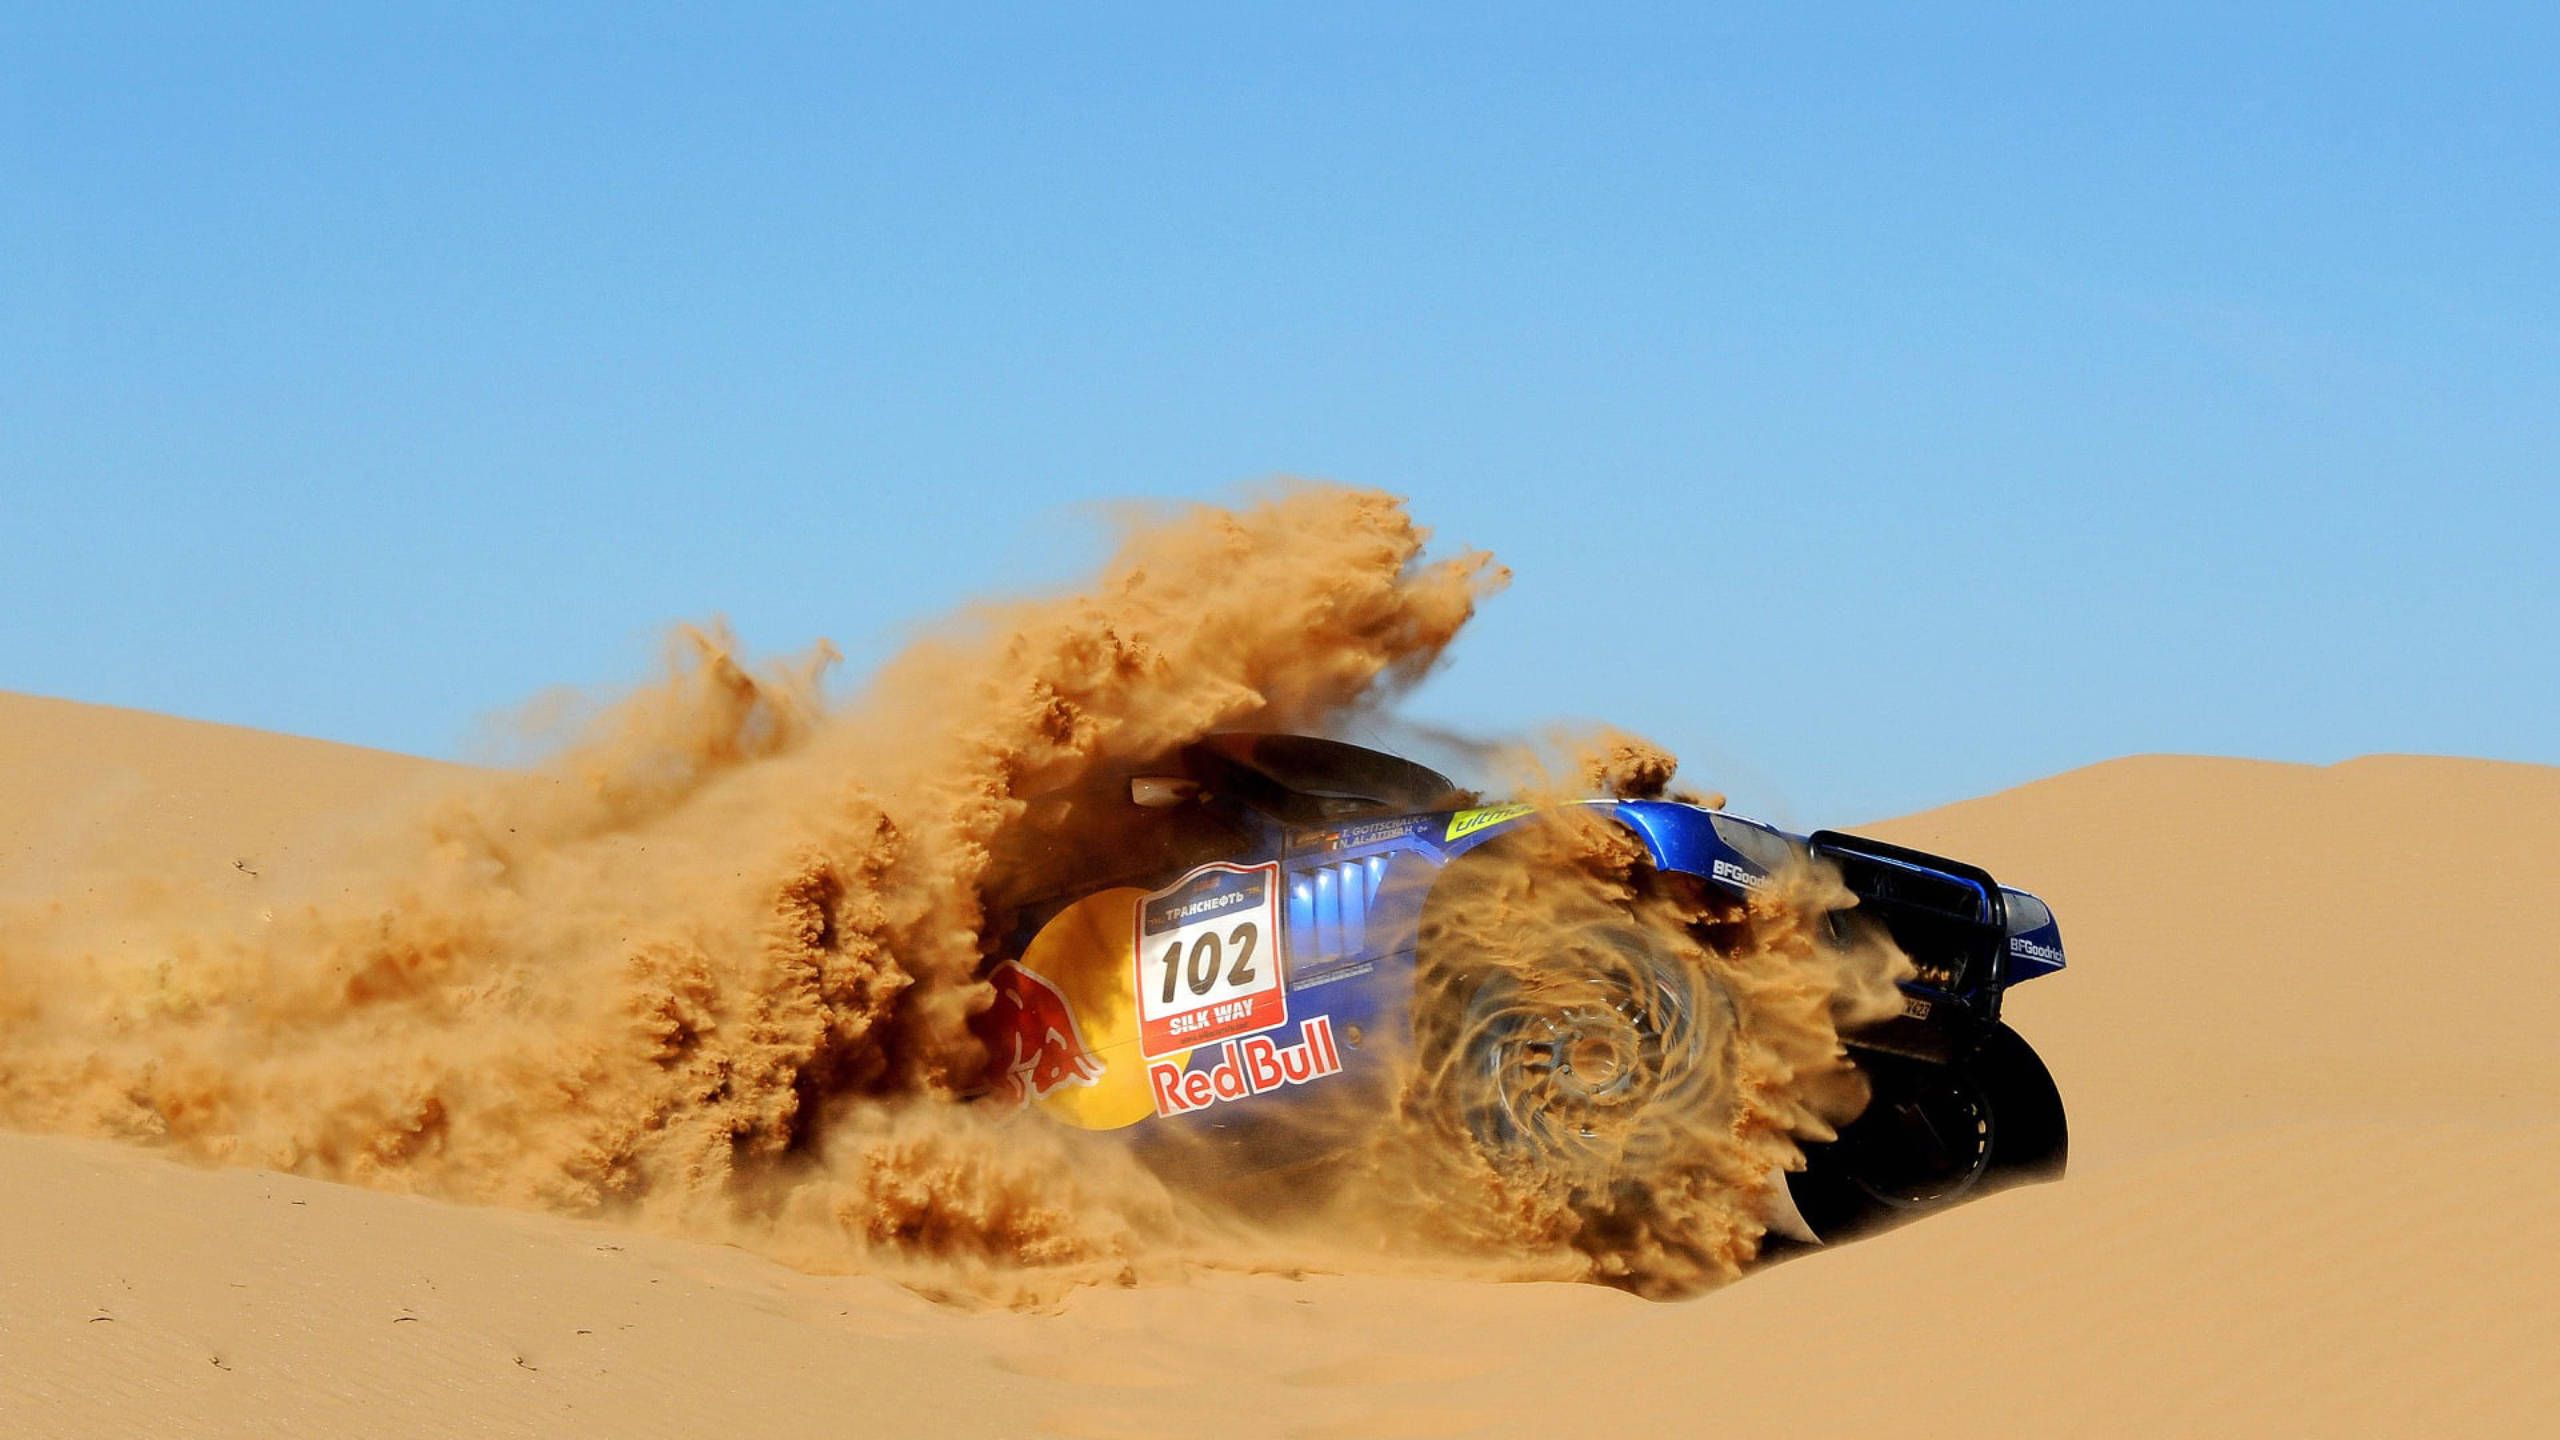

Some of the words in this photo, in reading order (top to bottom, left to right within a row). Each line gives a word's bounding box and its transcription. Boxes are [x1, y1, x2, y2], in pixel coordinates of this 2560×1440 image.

[1712, 859, 1767, 887] BFGood
[1165, 891, 1245, 921] ТРАНСНЕФТЬ
[1162, 922, 1258, 1004] 102
[1169, 1009, 1211, 1036] SILK
[1213, 998, 1254, 1025] WAY
[1149, 1042, 1247, 1116] Red
[1243, 1018, 1340, 1092] Bull
